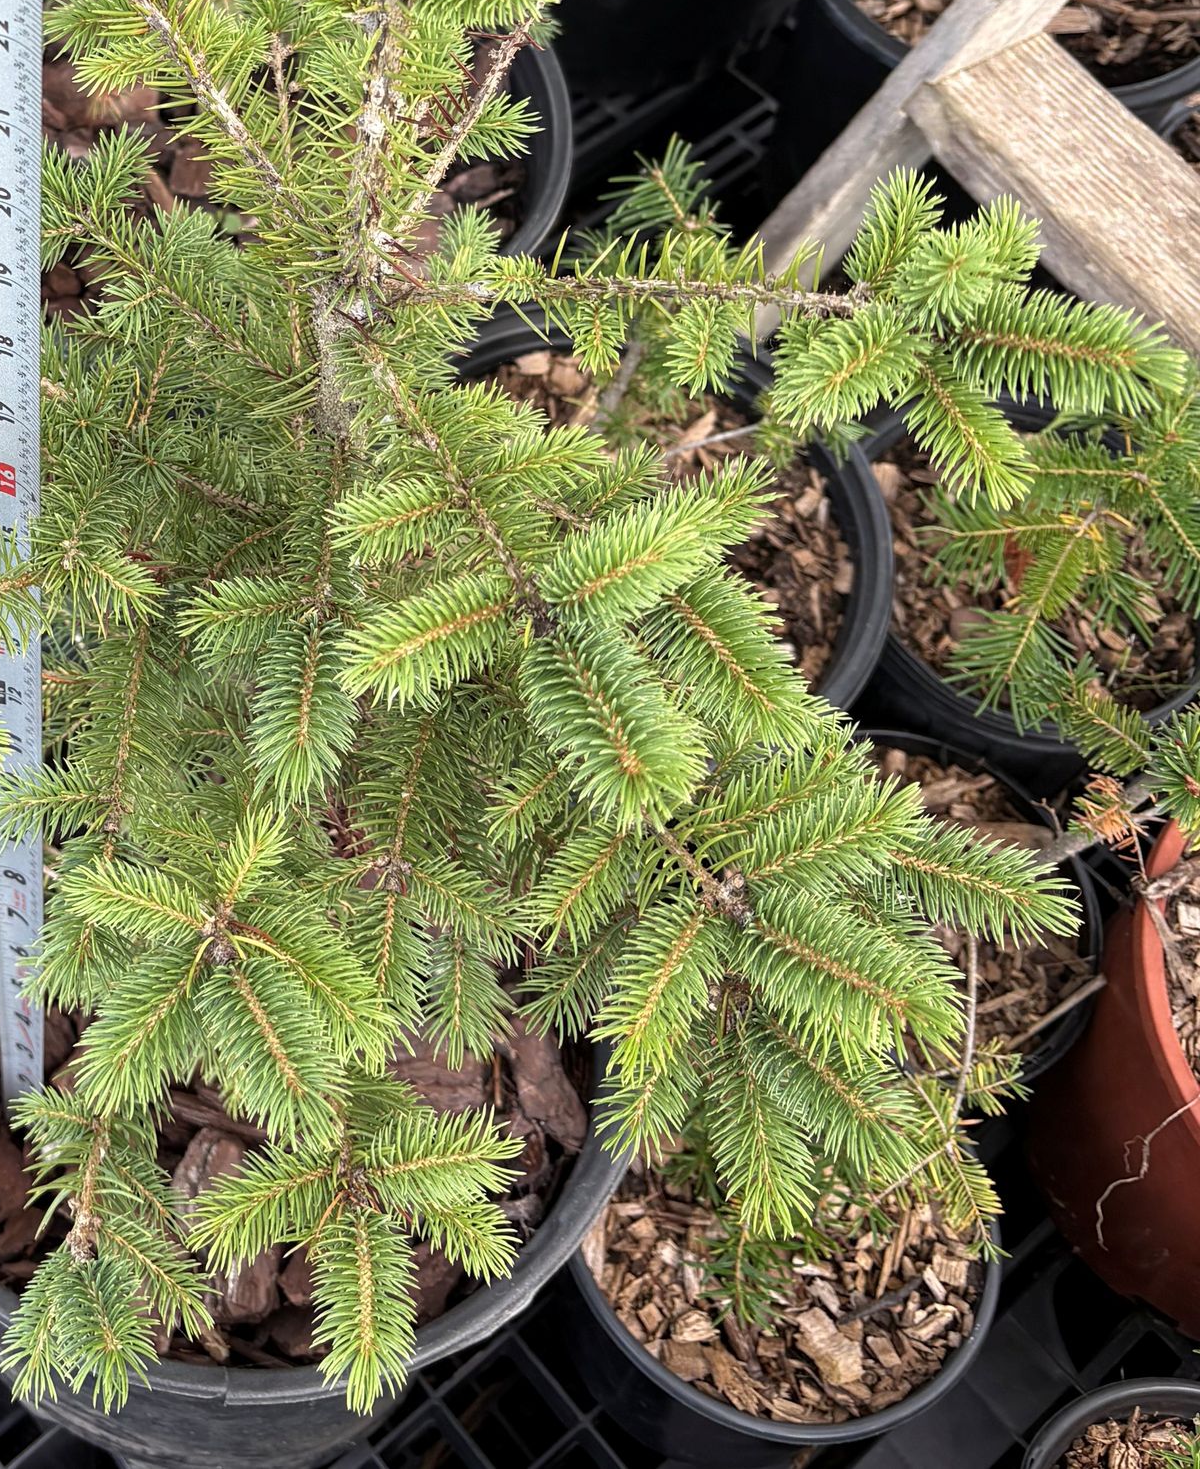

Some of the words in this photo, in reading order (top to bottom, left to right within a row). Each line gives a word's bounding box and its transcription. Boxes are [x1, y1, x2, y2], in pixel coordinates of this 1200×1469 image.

[0, 466, 15, 493] 16
[8, 686, 22, 705] 12
[3, 869, 27, 885] 8
[7, 906, 29, 926] 7
[9, 944, 29, 958] 6
[14, 1011, 32, 1026] 4
